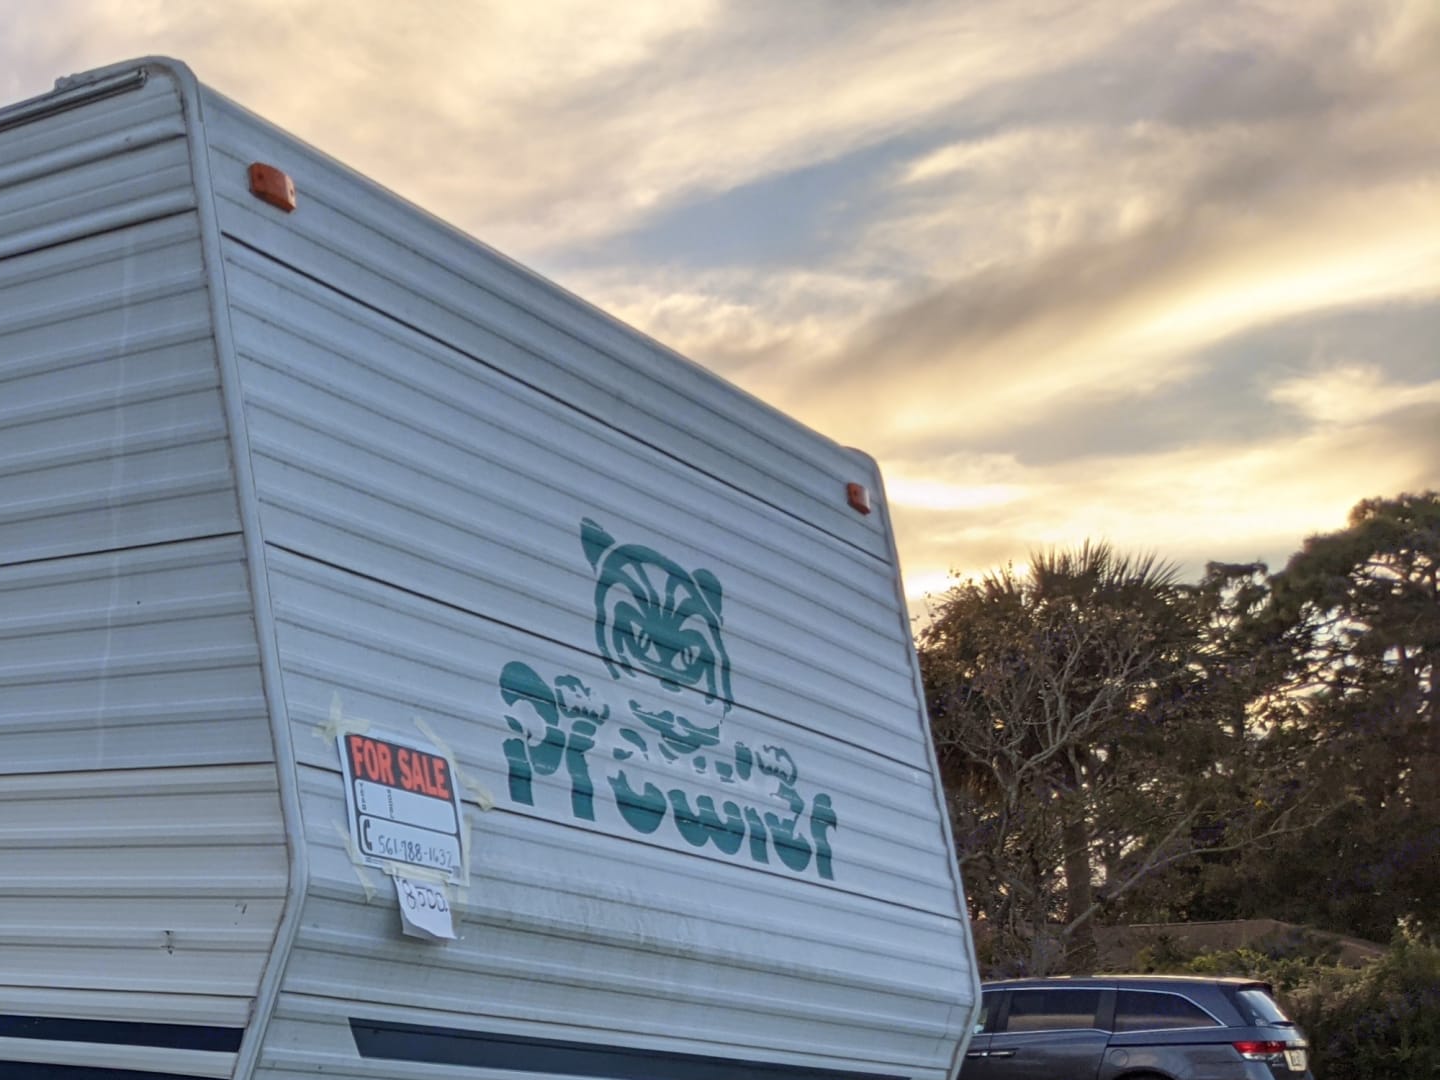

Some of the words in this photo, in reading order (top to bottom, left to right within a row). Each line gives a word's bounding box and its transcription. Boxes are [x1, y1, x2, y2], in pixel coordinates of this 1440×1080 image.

[350, 736, 395, 785] FOR
[398, 748, 449, 799] SALE
[499, 661, 838, 881] Prowler
